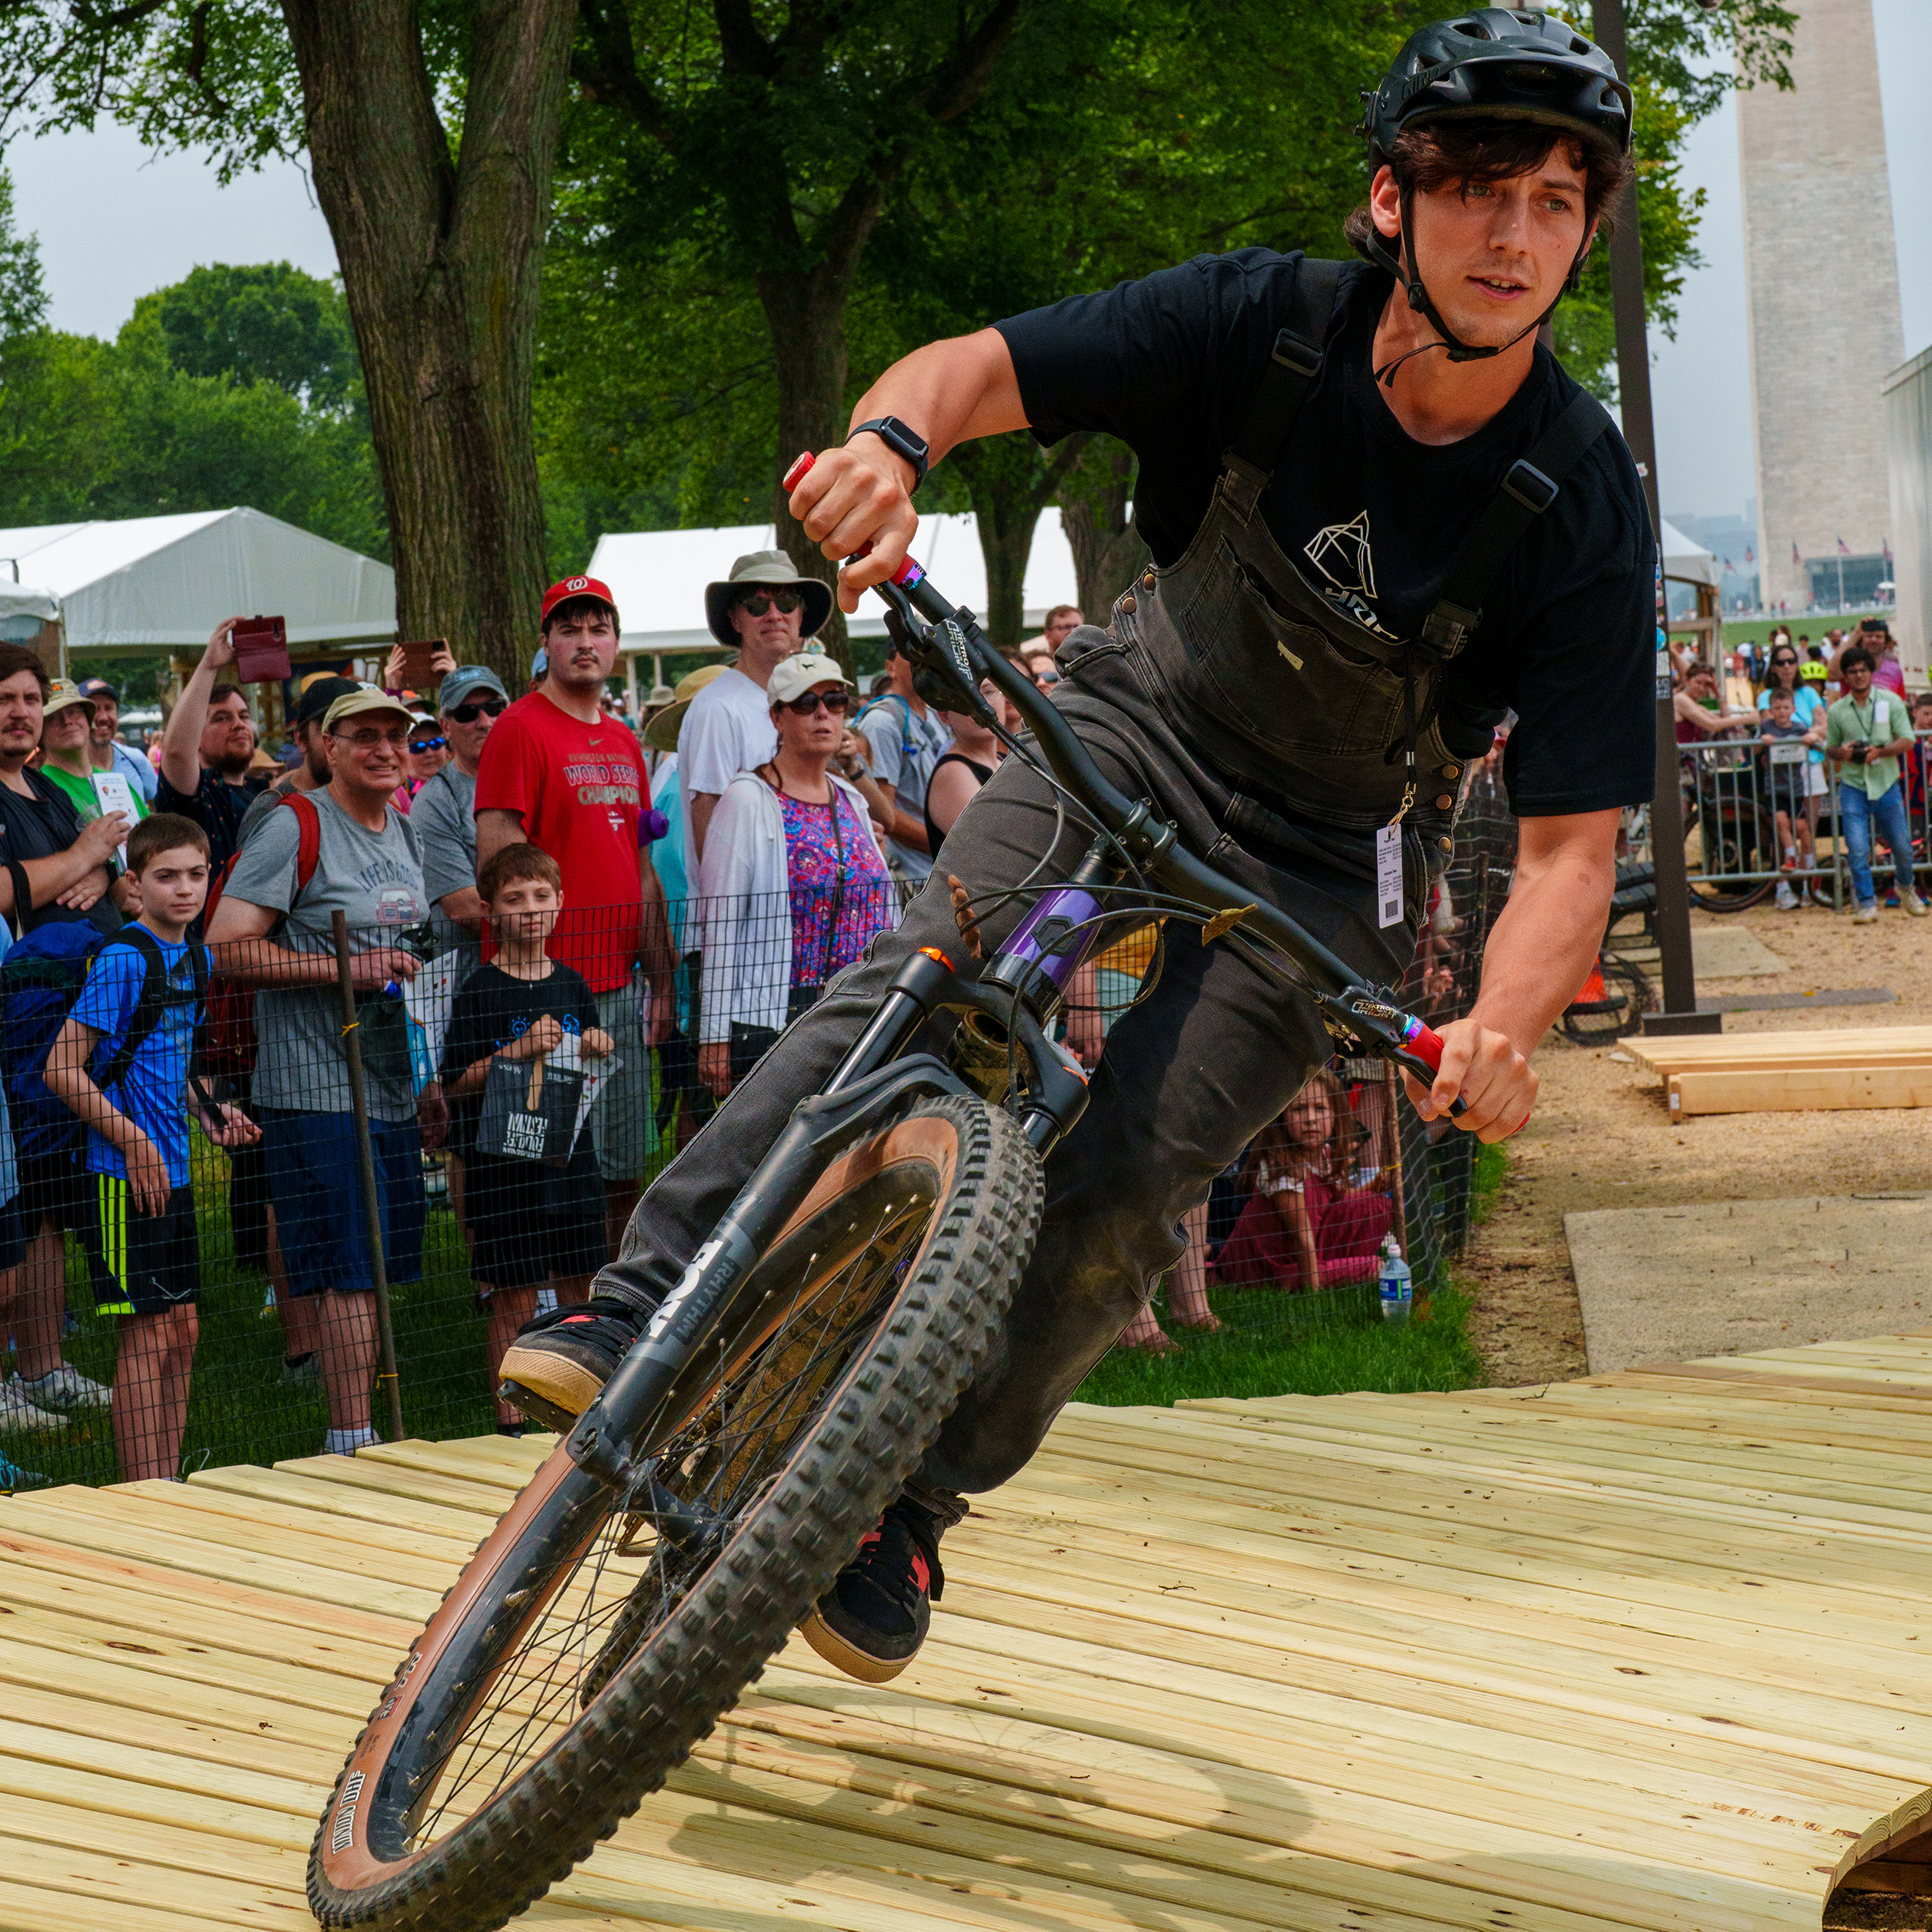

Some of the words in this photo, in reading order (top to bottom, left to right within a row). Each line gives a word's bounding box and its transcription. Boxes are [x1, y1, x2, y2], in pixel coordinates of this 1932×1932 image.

[956, 631, 970, 667] TEKTRO
[563, 763, 610, 787] WORLD
[352, 862, 385, 894] LIFE
[1364, 1001, 1391, 1012] TEKTRO
[507, 1111, 549, 1138] FESTIVAL
[675, 1261, 735, 1338] RHYTHM
[393, 1651, 422, 1691] TR
[339, 1769, 366, 1808] DHF
[332, 1804, 356, 1855] MINION
